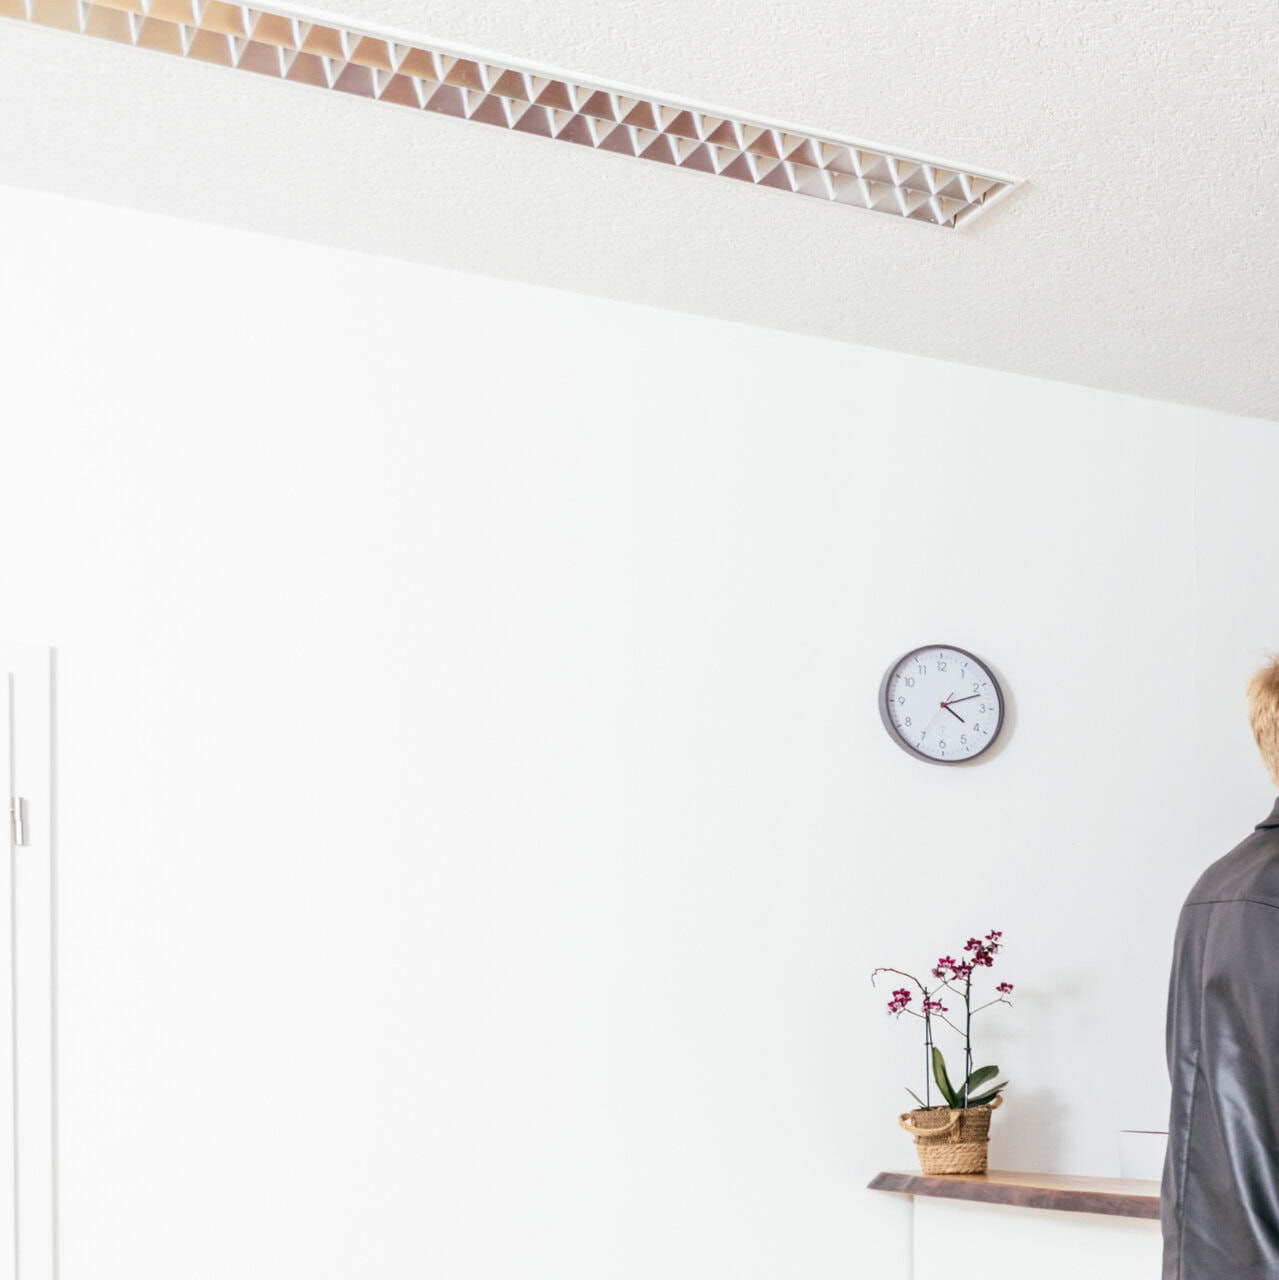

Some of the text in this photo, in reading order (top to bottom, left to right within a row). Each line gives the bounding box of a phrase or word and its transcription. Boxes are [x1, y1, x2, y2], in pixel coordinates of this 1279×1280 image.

[919, 665, 927, 675] 11
[937, 661, 947, 672] 12
[961, 669, 965, 679] 1
[904, 677, 915, 688] 10
[973, 683, 980, 693] 2
[898, 697, 906, 706] 9
[979, 704, 986, 714] 3
[905, 717, 912, 727] 8
[973, 723, 980, 732] 4
[920, 731, 927, 741] 7
[960, 735, 968, 744] 5
[939, 740, 946, 749] 6
